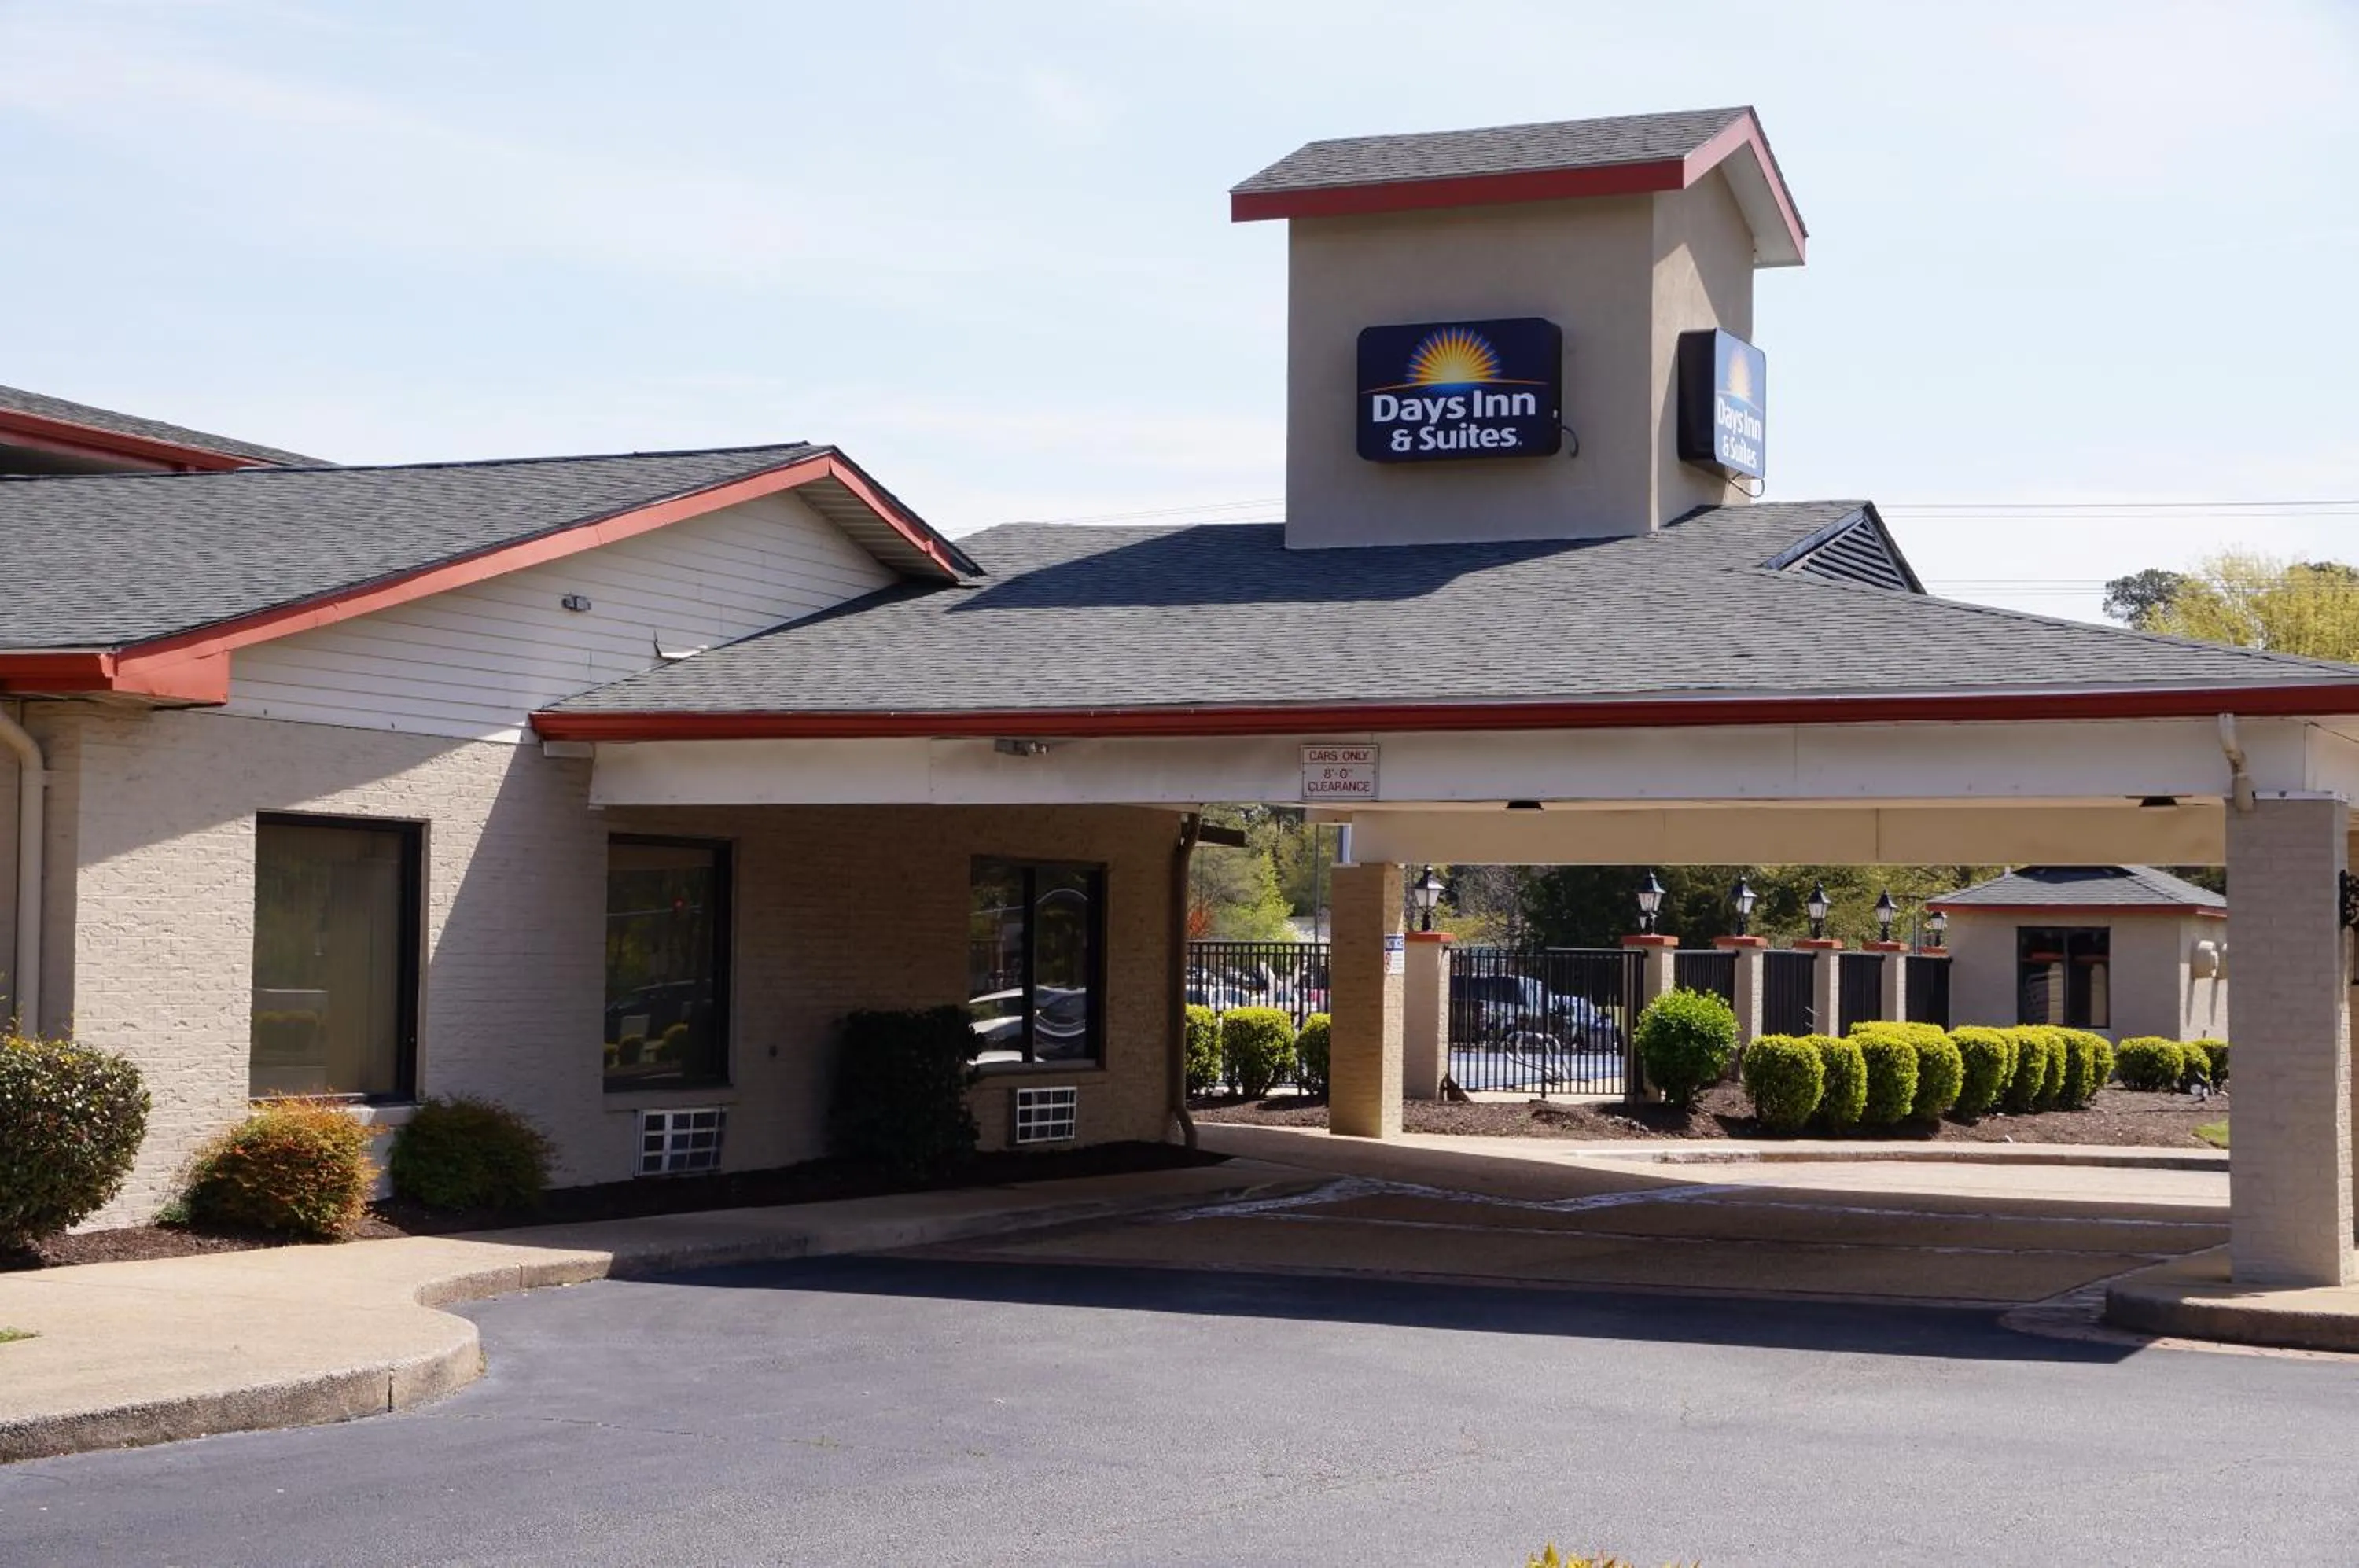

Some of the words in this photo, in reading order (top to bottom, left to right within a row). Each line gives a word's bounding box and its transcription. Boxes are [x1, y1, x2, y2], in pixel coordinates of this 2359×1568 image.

[1373, 394, 1467, 423] Days
[1473, 390, 1536, 418] Inn
[1717, 396, 1743, 435] Days
[1743, 409, 1761, 442] Inn
[1390, 429, 1412, 451] &
[1419, 423, 1518, 451] Suites
[1309, 750, 1338, 761] CARS
[1342, 750, 1370, 761] ONLY
[1308, 782, 1371, 792] CLEARANCE
